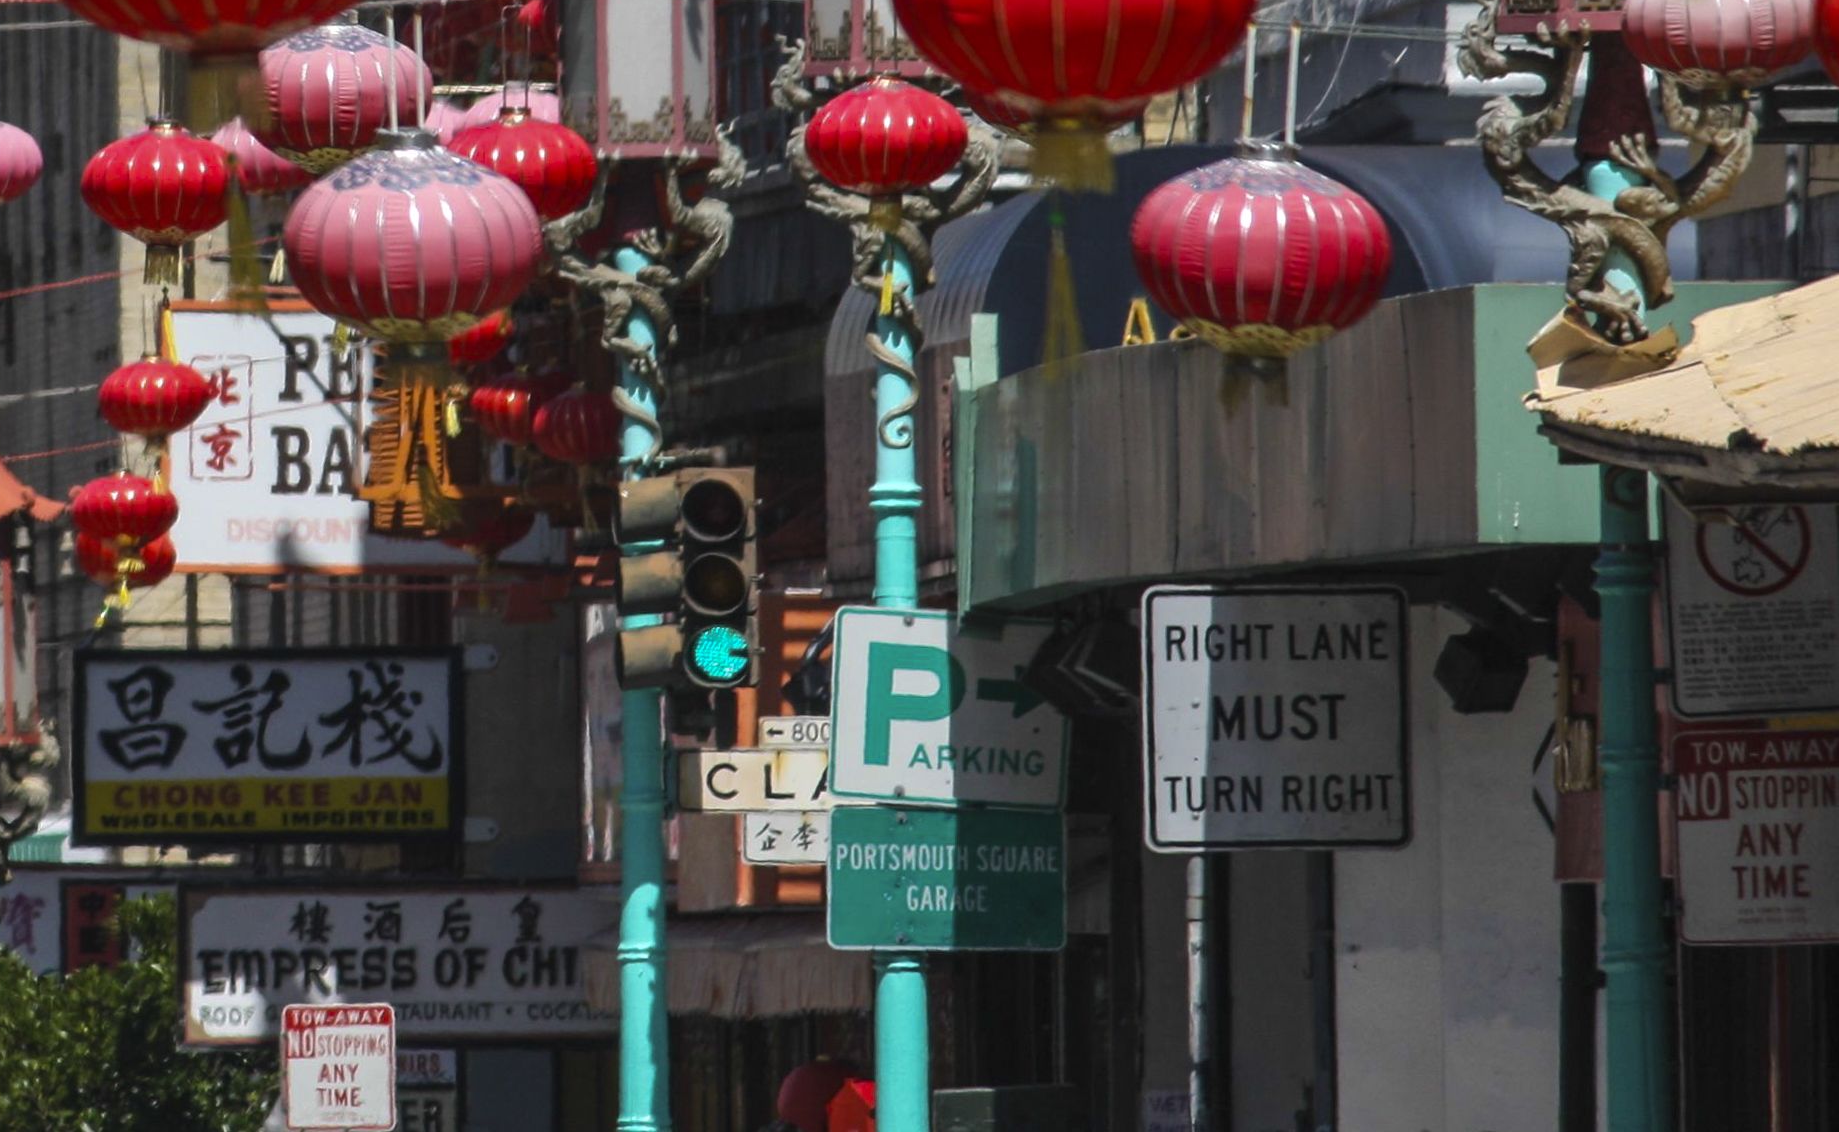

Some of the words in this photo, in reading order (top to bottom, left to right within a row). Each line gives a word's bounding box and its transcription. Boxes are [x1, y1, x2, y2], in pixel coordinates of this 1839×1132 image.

[270, 426, 369, 495] BA
[1165, 624, 1273, 661] RIGHT
[1288, 622, 1389, 660] LANE
[1212, 694, 1345, 742] MUST
[1691, 738, 1839, 764] TOW-AWAY
[114, 783, 241, 809] CHONG
[264, 783, 331, 806] KEE
[351, 782, 423, 805] JAN
[1163, 776, 1263, 813] TURN
[1282, 774, 1392, 813] RIGHT
[1678, 772, 1721, 817] NO
[101, 811, 256, 829] WHOLESALE
[282, 809, 435, 828] IMPORTERS
[1736, 823, 1803, 857] ANY
[837, 844, 969, 870] PORTSMOUTH
[977, 845, 1058, 873] SQUARE
[1732, 865, 1810, 900] TIME
[907, 885, 989, 912] GARAGE
[198, 947, 416, 995] EMPRESS
[435, 947, 487, 988] OF
[503, 946, 581, 988] CHI
[293, 1009, 384, 1025] TOW-AWAY
[396, 1003, 493, 1021] TAURANT
[288, 1030, 315, 1057] NO
[318, 1034, 386, 1056] STOPPING
[318, 1064, 359, 1083] ANY
[316, 1087, 362, 1107] TIME
